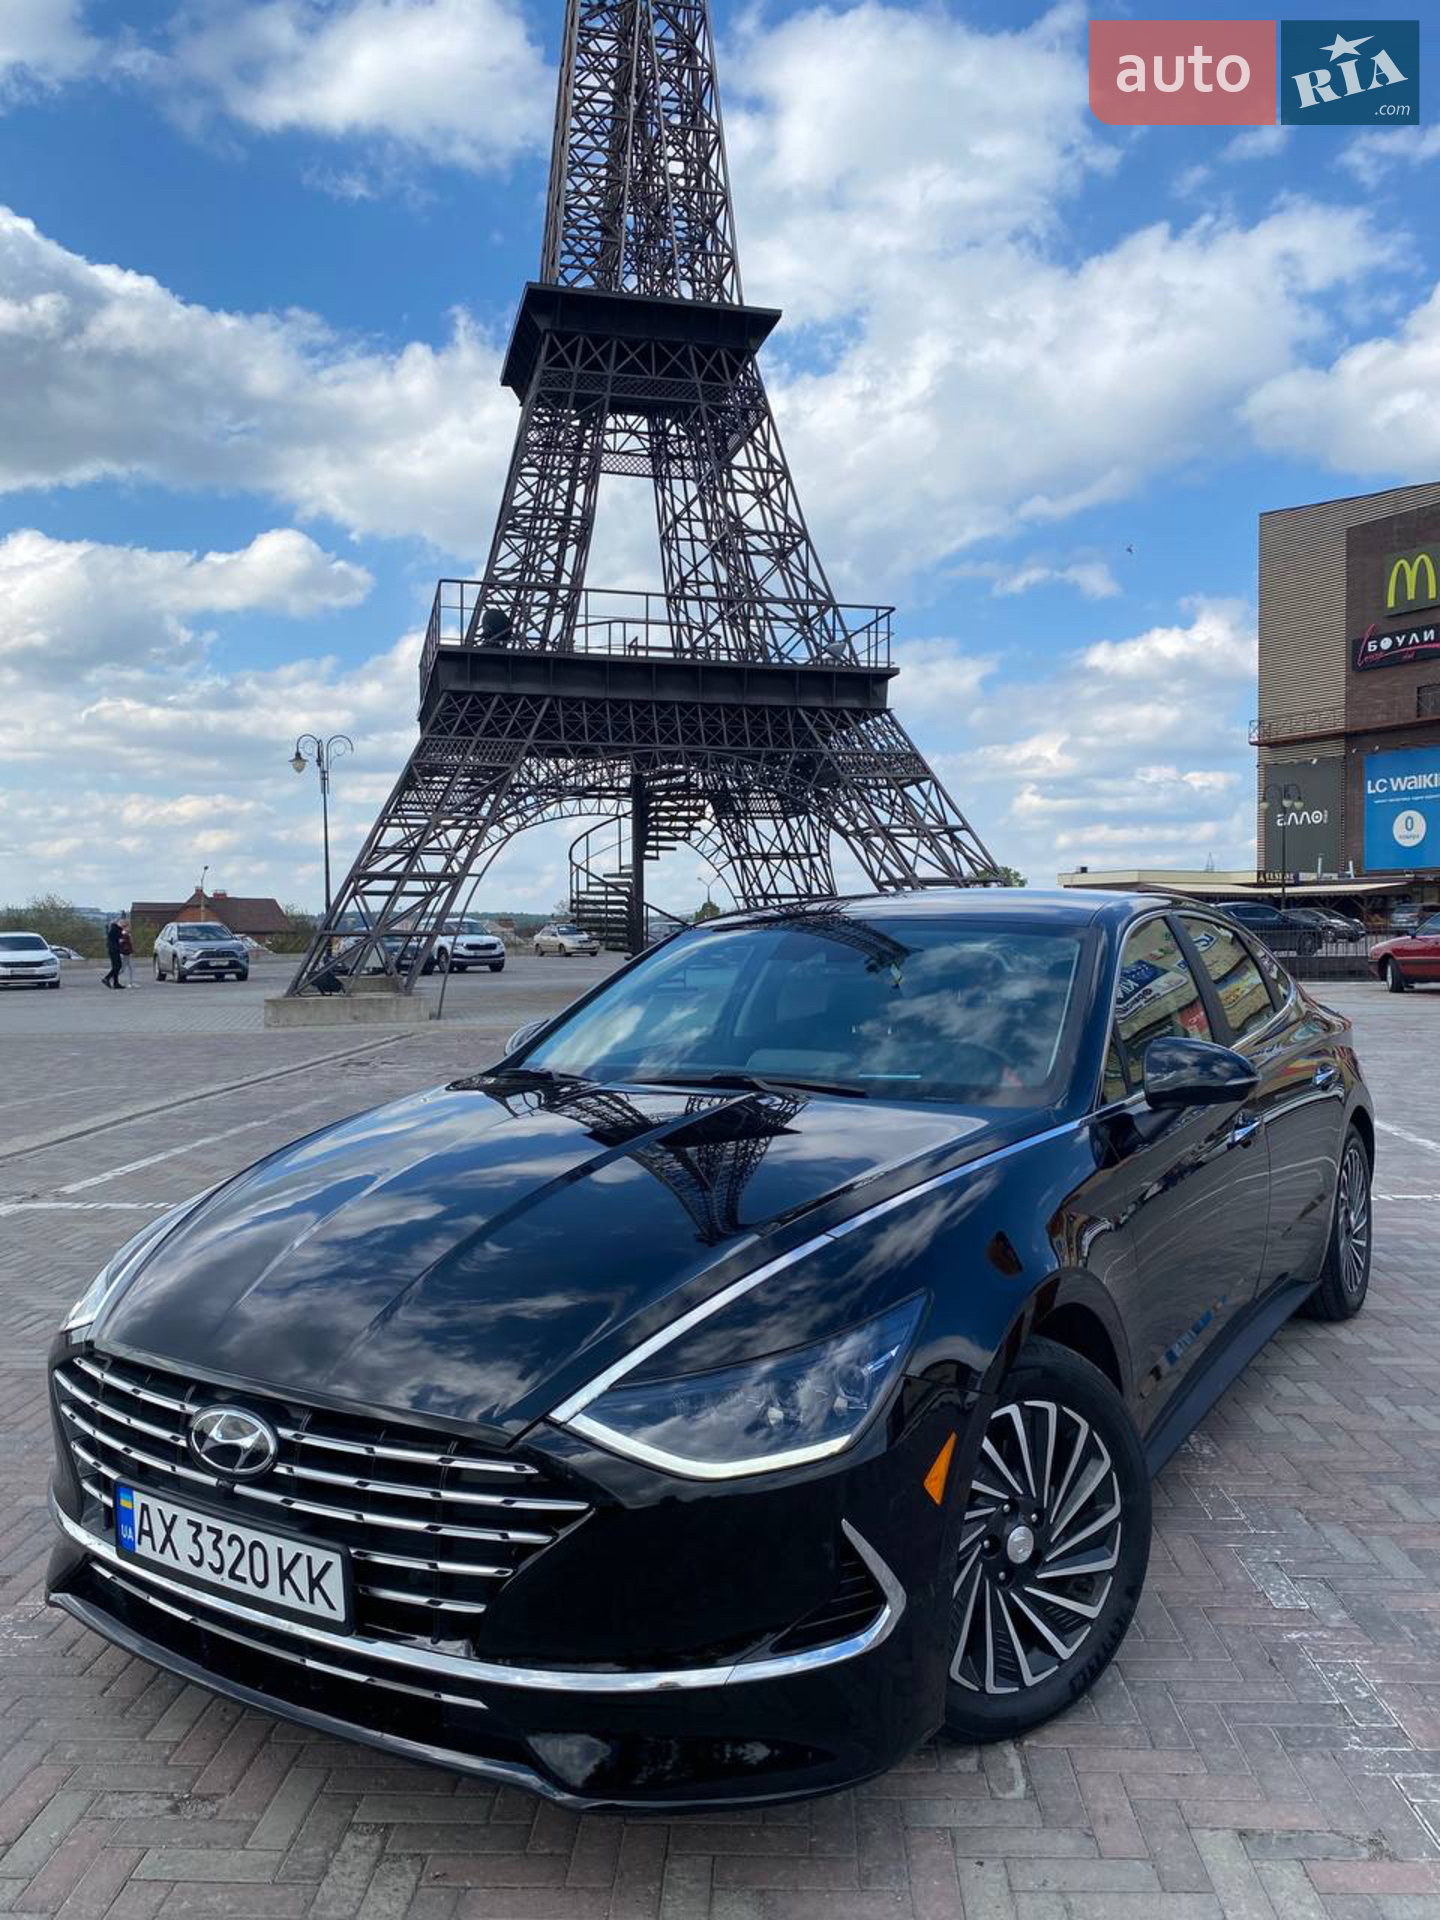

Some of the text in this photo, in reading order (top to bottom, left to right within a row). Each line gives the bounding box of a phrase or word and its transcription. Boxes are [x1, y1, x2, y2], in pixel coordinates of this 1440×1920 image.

[1367, 778, 1388, 794] LC
[121, 1526, 135, 1541] UA
[138, 1503, 337, 1611] AX 3320 KK
